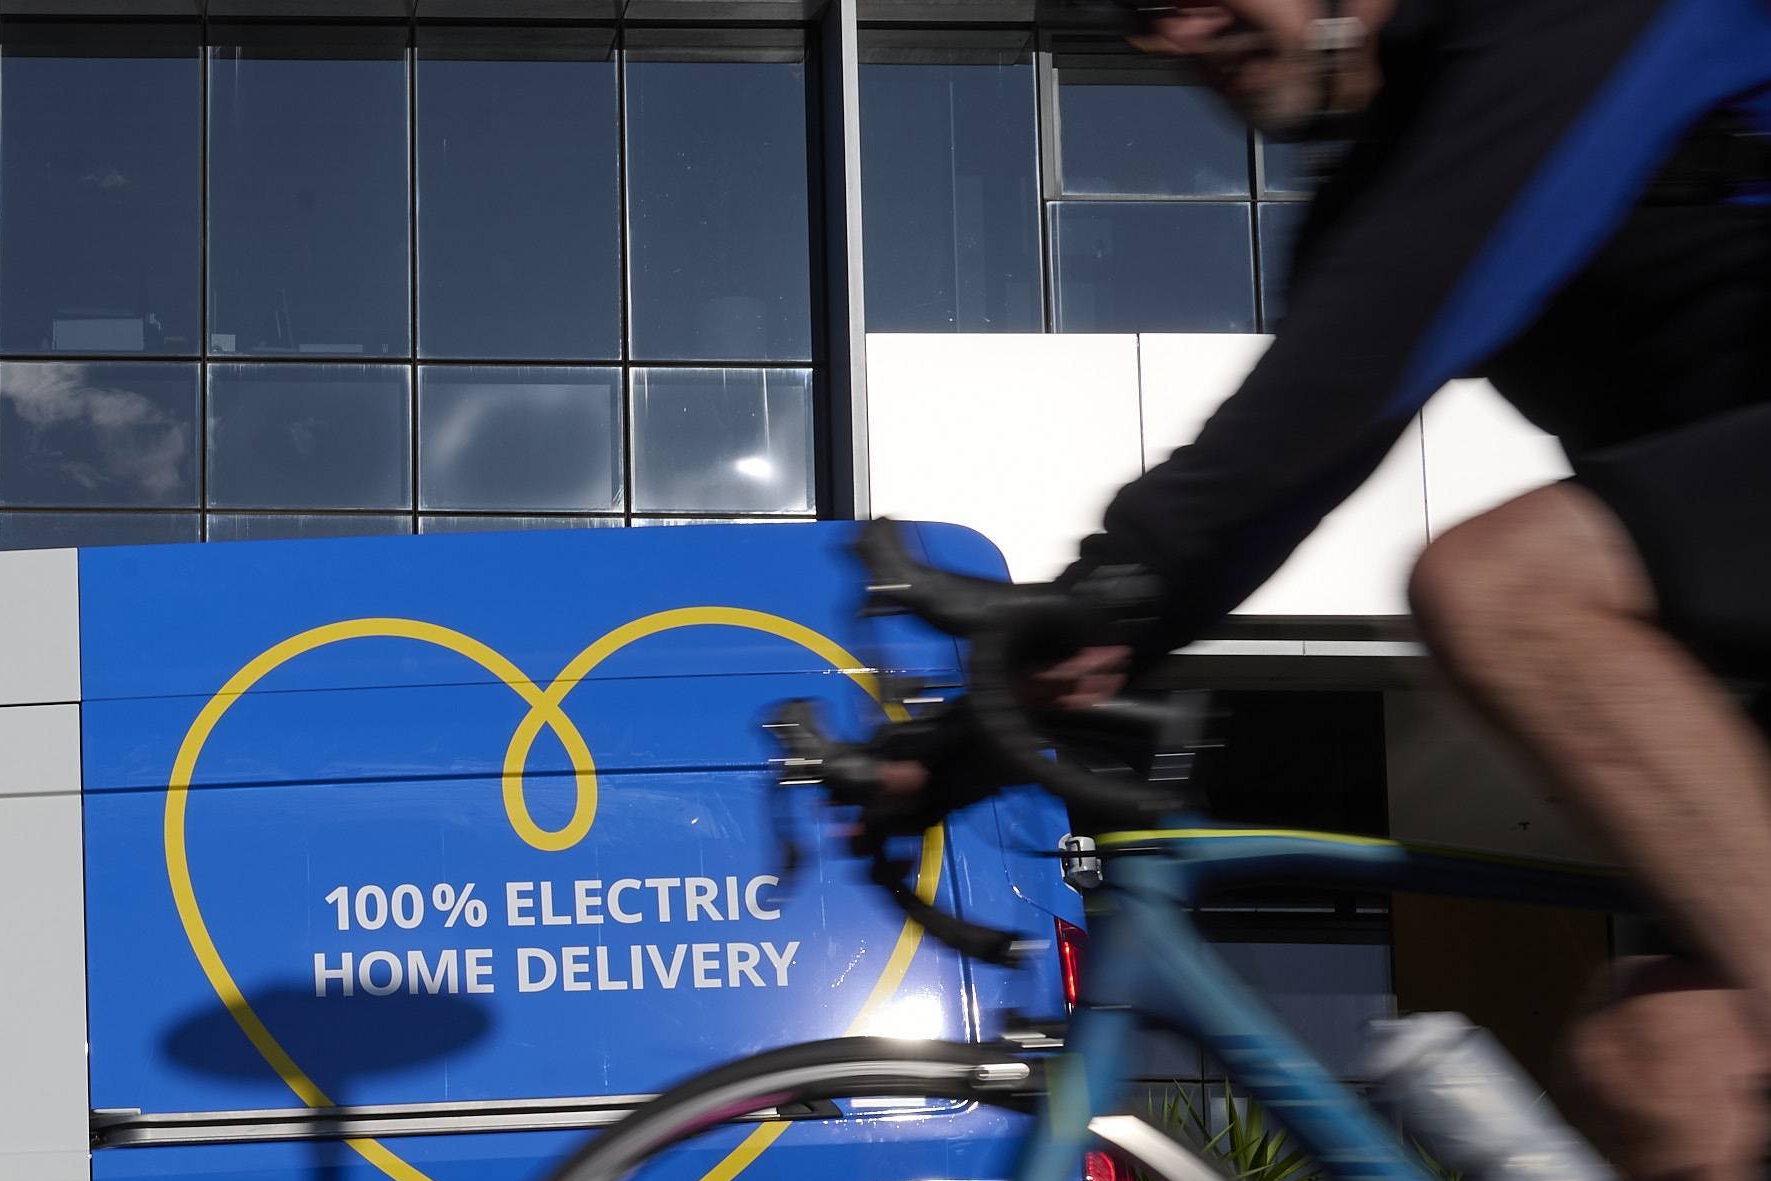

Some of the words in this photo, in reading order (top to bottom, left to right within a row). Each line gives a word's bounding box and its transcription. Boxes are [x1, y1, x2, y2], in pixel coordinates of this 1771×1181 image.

[324, 882, 488, 931] 100%
[506, 875, 782, 927] ELECTRIC
[314, 948, 496, 998] HOME
[516, 940, 802, 993] DELIVERY
